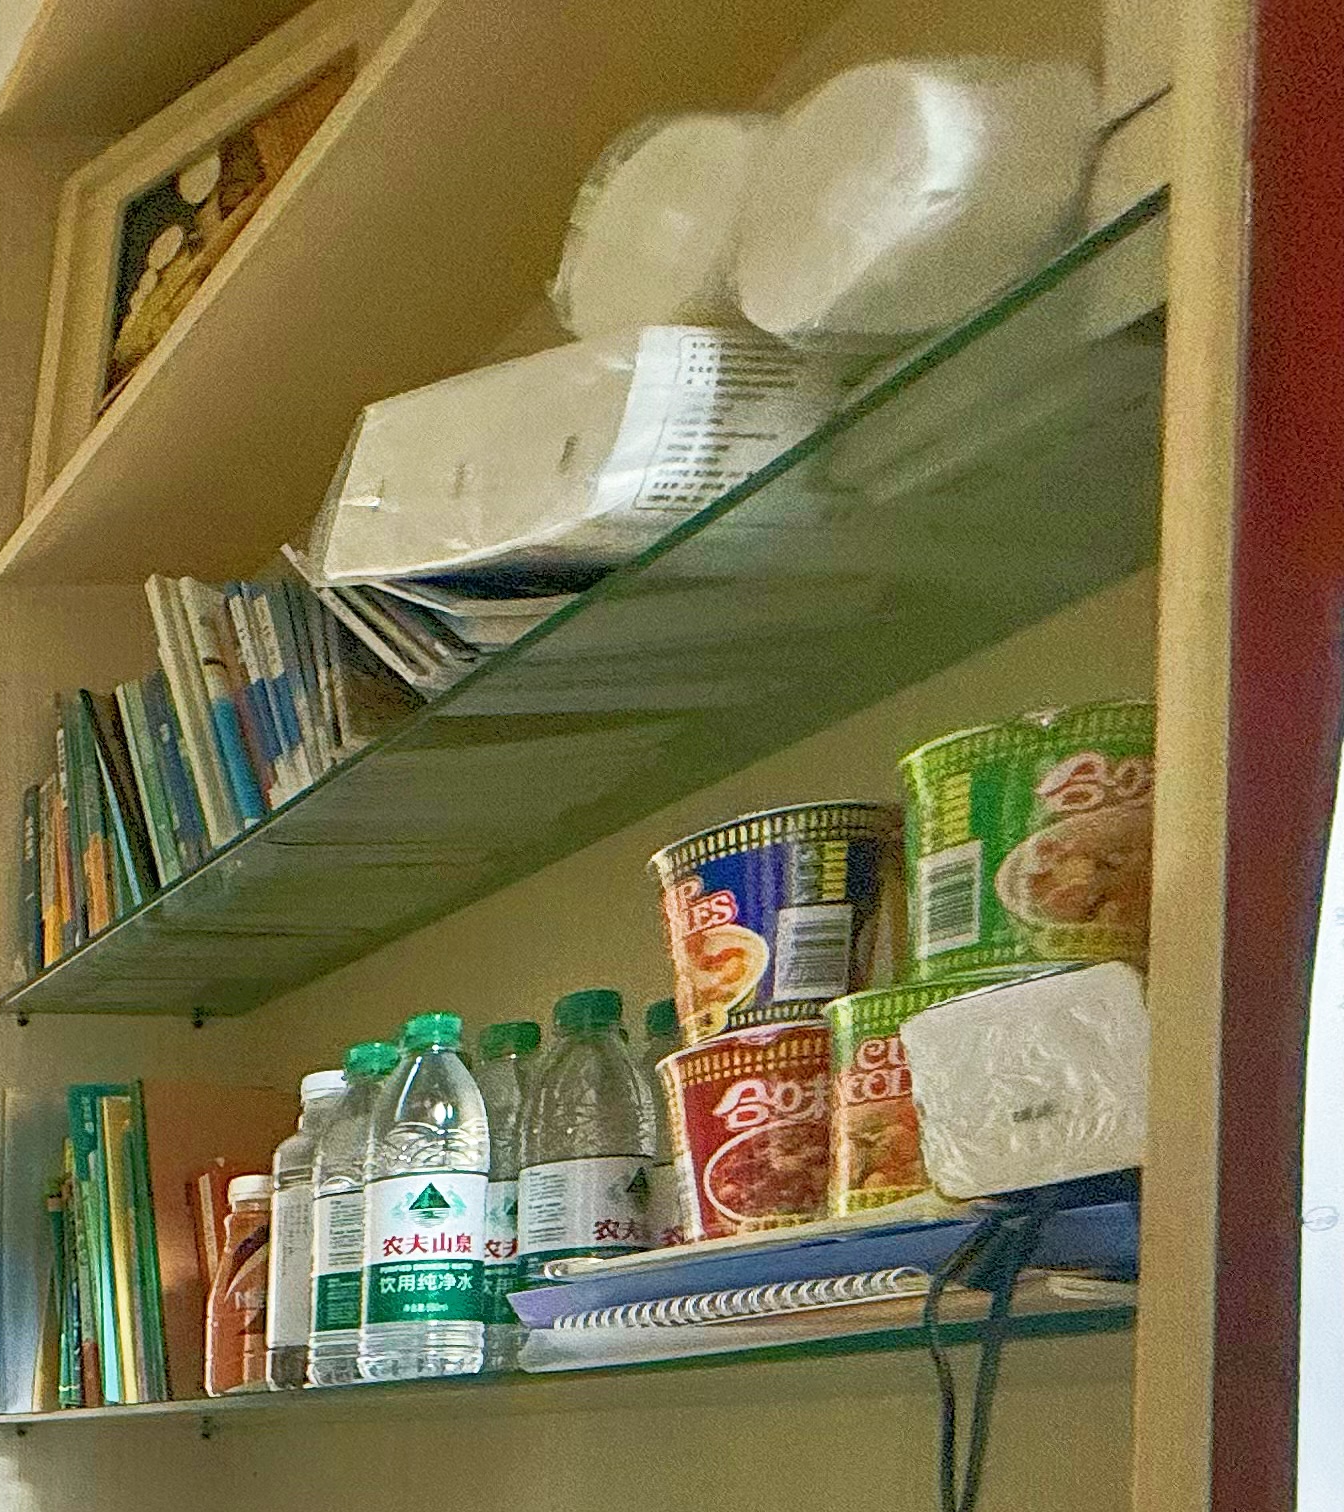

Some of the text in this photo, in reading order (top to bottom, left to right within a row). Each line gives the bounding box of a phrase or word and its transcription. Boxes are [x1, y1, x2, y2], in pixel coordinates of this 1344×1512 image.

[382, 1232, 473, 1257] 农夫山泉
[379, 1272, 474, 1294] 饮用纯净水
